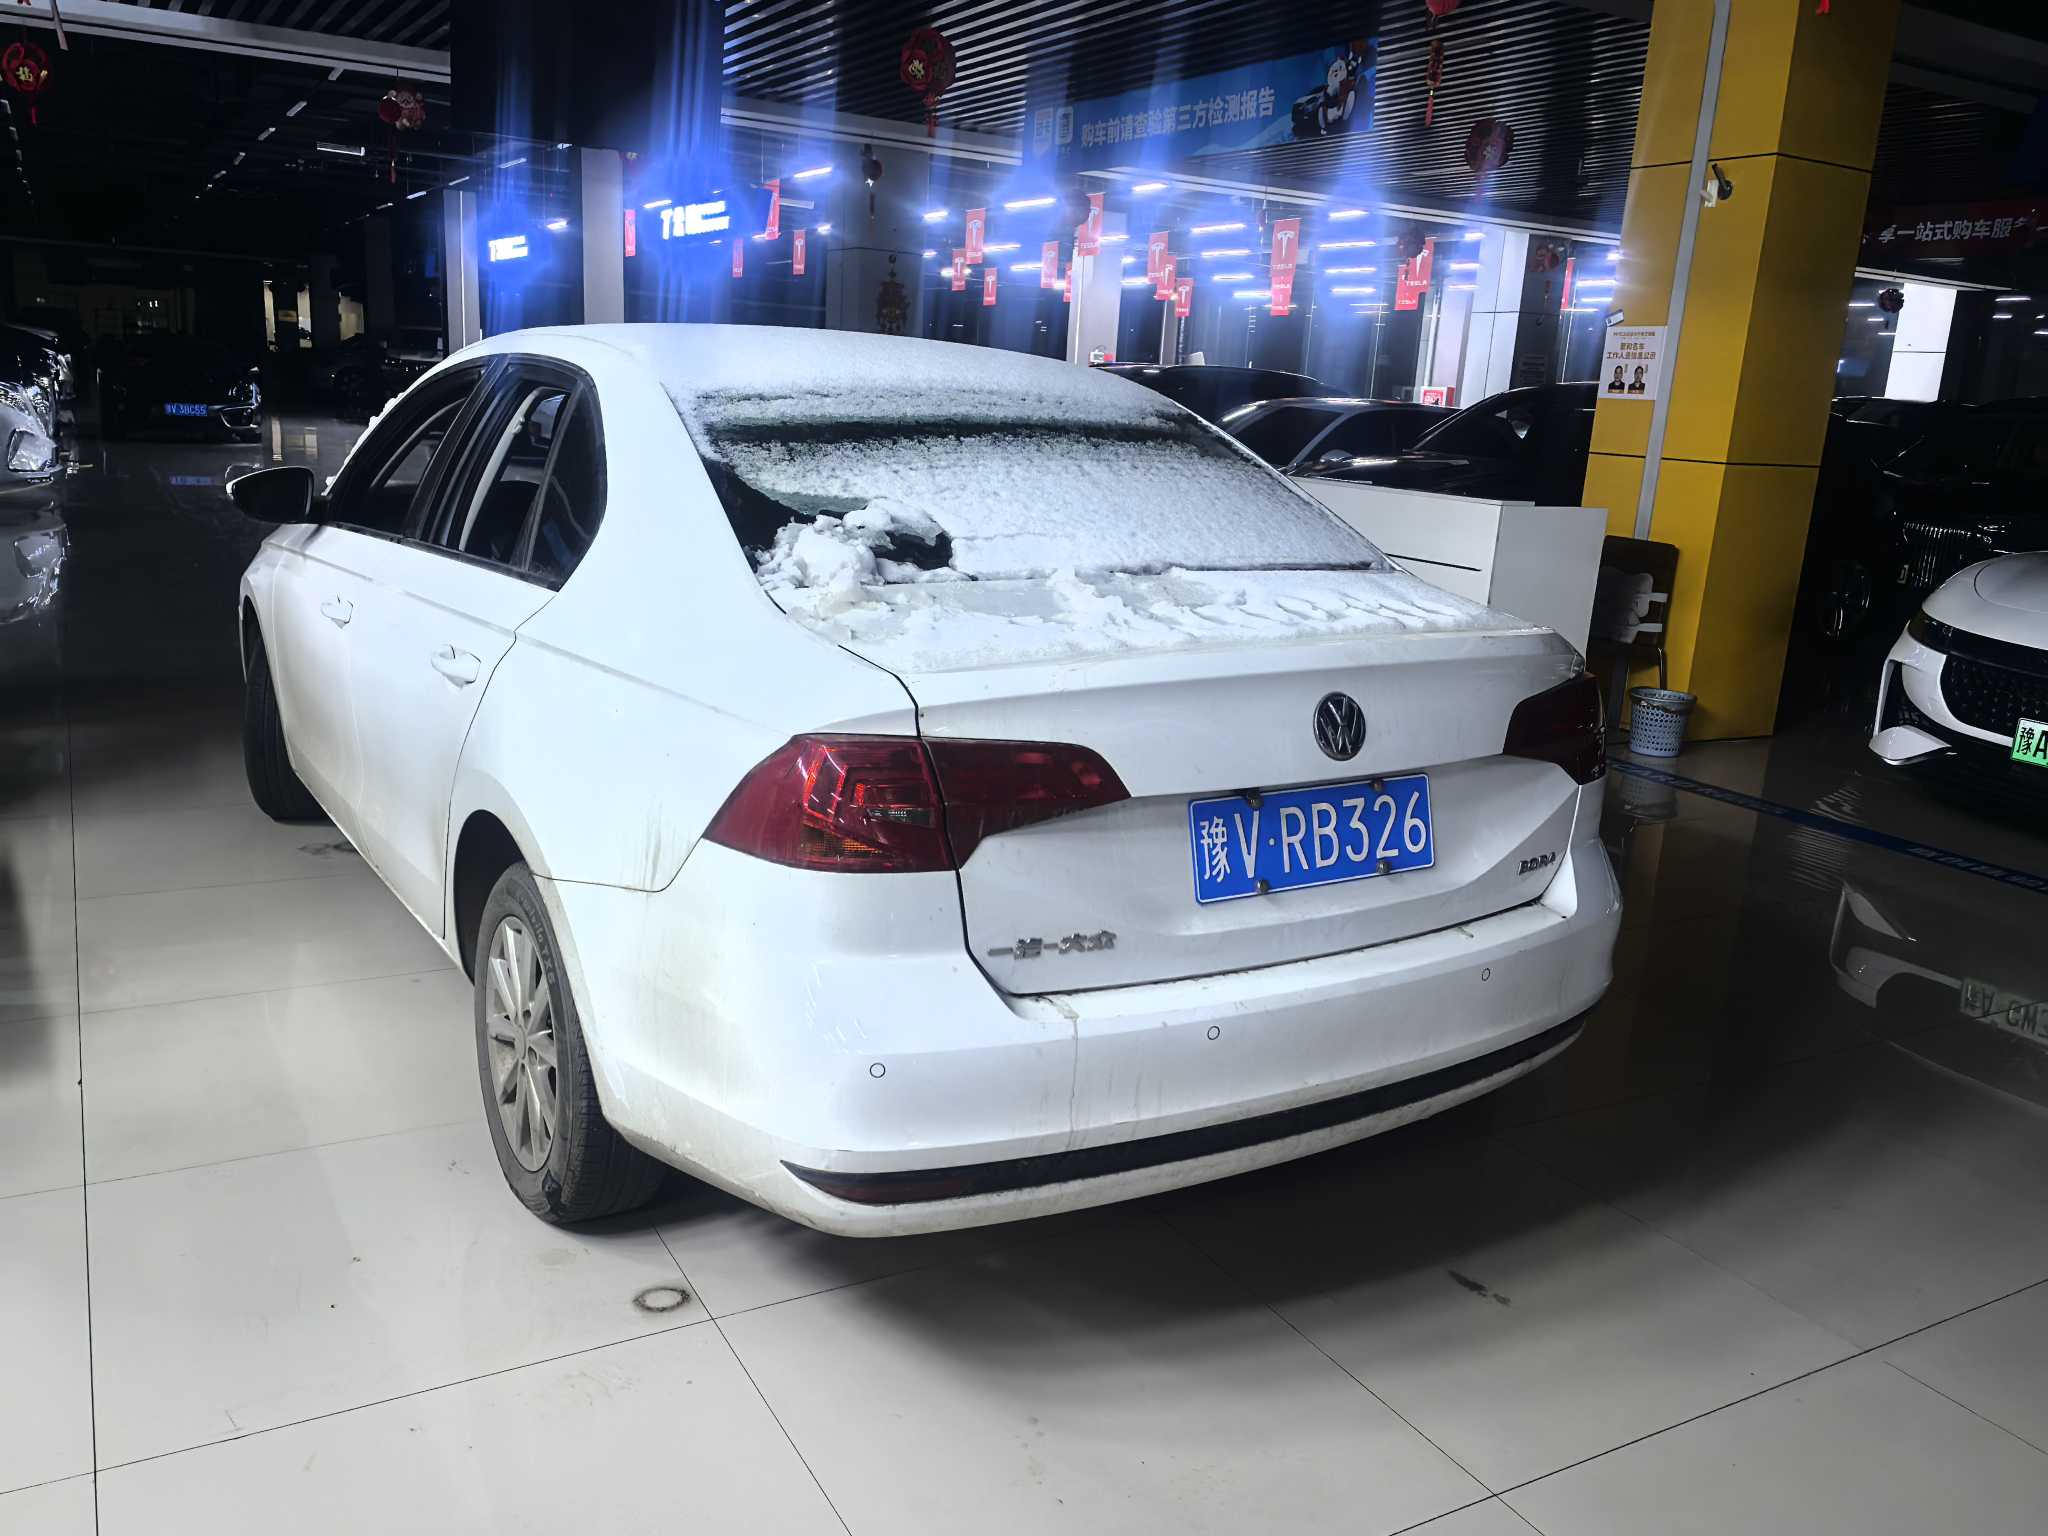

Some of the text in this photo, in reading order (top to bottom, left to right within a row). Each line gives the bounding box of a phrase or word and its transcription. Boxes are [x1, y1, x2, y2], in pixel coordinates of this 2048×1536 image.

[1080, 86, 1275, 148] 购车前请查验第三方检测报告
[1200, 791, 1427, 884] 豫V·RB326
[1518, 851, 1556, 876] BORA
